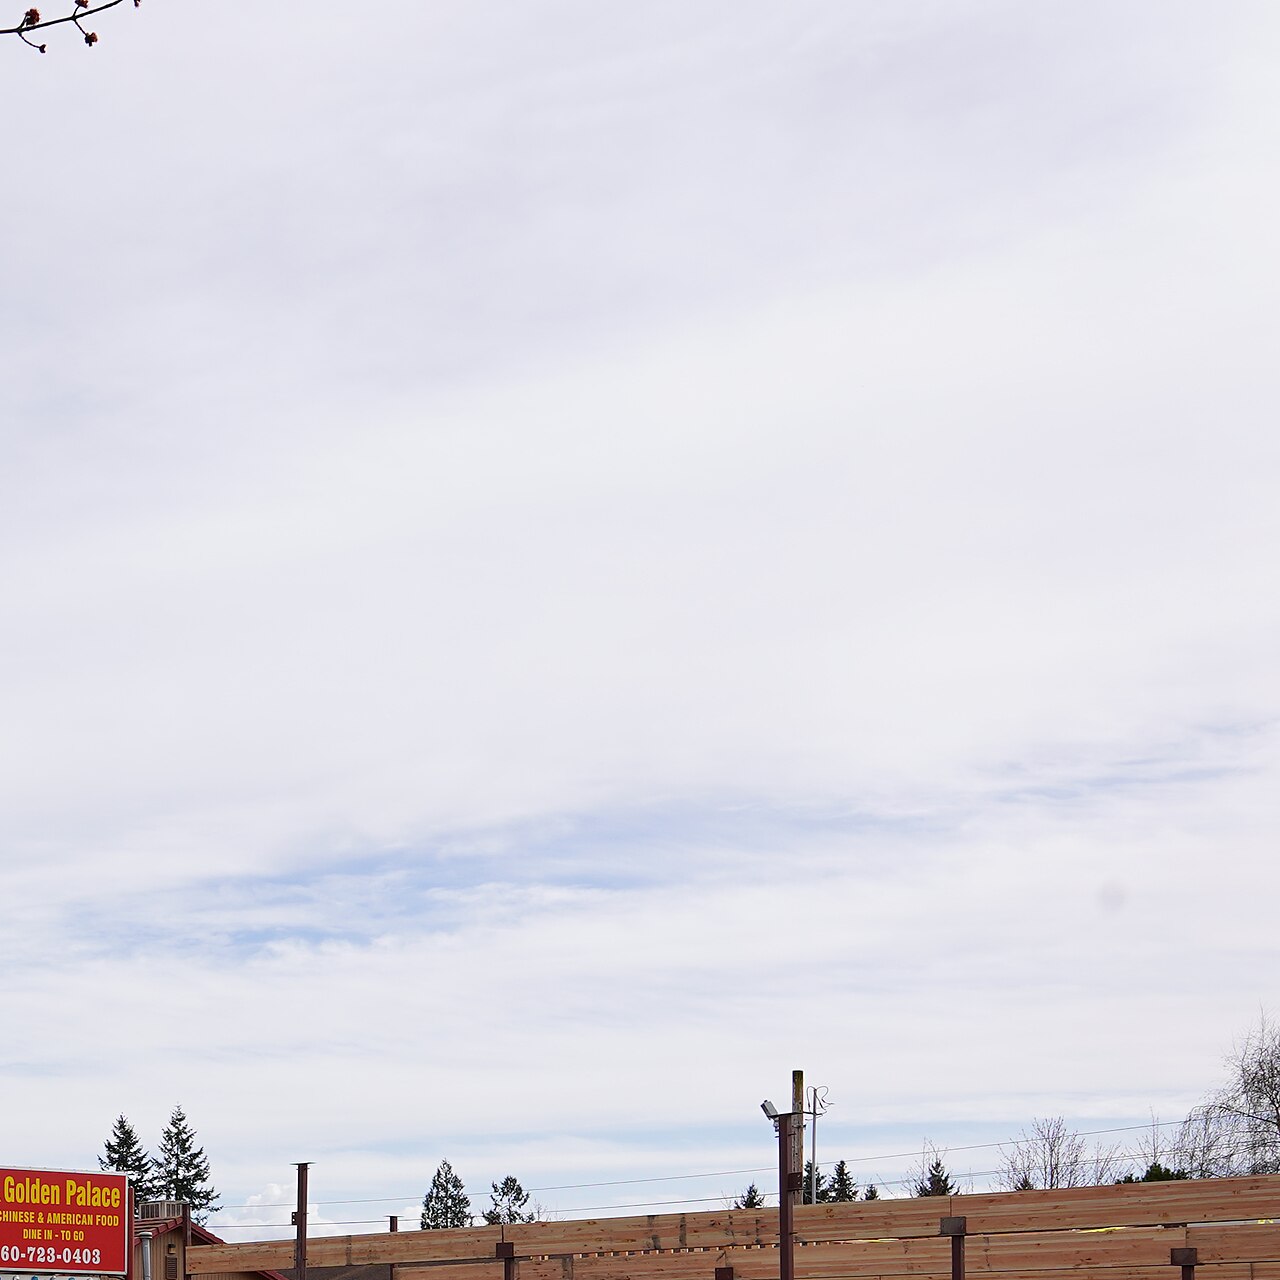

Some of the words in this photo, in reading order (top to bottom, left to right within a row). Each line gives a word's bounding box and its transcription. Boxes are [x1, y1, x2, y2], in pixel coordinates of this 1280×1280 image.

[4, 1175, 60, 1205] Golden
[66, 1179, 121, 1208] Palace
[37, 1212, 44, 1224] &
[47, 1212, 93, 1225] AMERICAN
[96, 1214, 119, 1227] FOOD
[23, 1228, 42, 1240] DINE
[44, 1229, 53, 1240] IN
[61, 1230, 72, 1241] TO
[73, 1230, 84, 1242] GO
